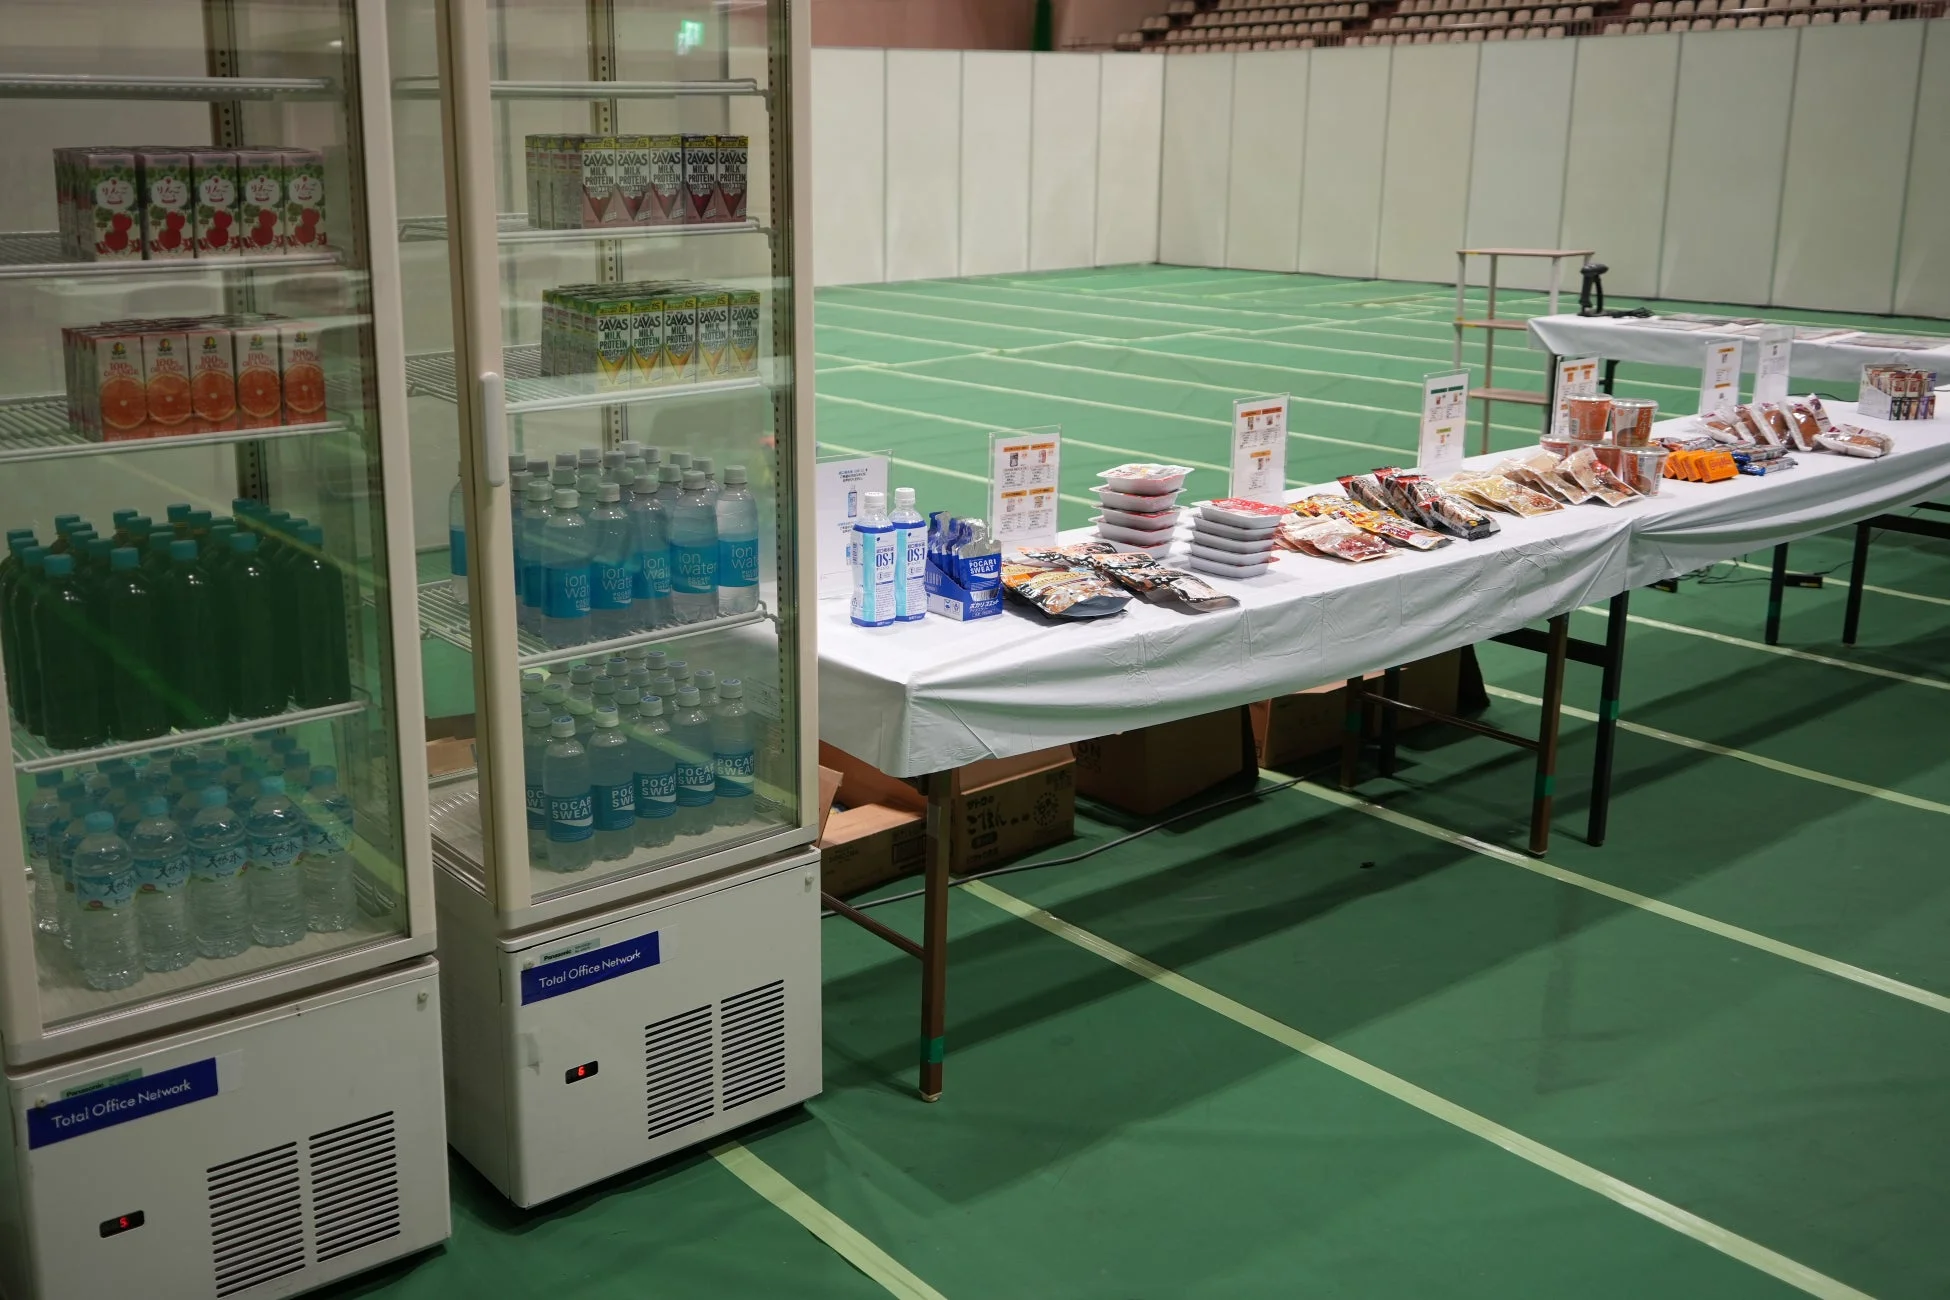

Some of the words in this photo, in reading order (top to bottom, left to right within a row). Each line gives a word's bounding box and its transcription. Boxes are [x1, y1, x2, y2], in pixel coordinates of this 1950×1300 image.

[584, 153, 614, 167] SAVAS
[618, 152, 648, 166] SAVAS
[652, 151, 681, 165] SAVAS
[687, 152, 715, 165] SAVAS
[720, 151, 747, 165] SAVAS
[590, 166, 608, 176] MILK
[624, 166, 641, 175] MILK
[658, 165, 674, 174] MILK
[692, 164, 708, 174] MILK
[724, 164, 740, 173] MILK
[585, 175, 614, 185] PROTEIN
[619, 175, 647, 184] PROTEIN
[653, 174, 680, 183] PROTEIN
[688, 174, 715, 183] PROTEIN
[719, 173, 747, 183] PROTEIN
[665, 313, 694, 327] SAVAS
[700, 311, 726, 323] SAVAS
[731, 308, 758, 321] SAVAS
[599, 318, 628, 331] SAVAS
[633, 316, 660, 329] SAVAS
[604, 331, 621, 340] MILK
[639, 328, 654, 337] MILK
[671, 325, 687, 335] MILK
[599, 340, 627, 350] PROTEIN
[634, 337, 660, 347] PROTEIN
[666, 334, 693, 344] PROTEIN
[732, 545, 753, 558] ion
[907, 547, 925, 563] OS-1
[643, 556, 665, 569] ion
[680, 552, 701, 564] ion
[876, 552, 894, 567] OS-1
[969, 558, 997, 569] POCARI
[603, 567, 625, 579] ion
[970, 565, 995, 575] SWEAT
[565, 573, 586, 587] ion
[543, 949, 572, 961] Panasonic
[538, 971, 566, 989] Total
[568, 964, 601, 980] Office
[602, 949, 641, 971] Network
[578, 1067, 586, 1076] 6
[50, 1107, 89, 1129] Total
[92, 1098, 135, 1117] Office
[138, 1079, 192, 1104] Network
[120, 1216, 129, 1228] 5
